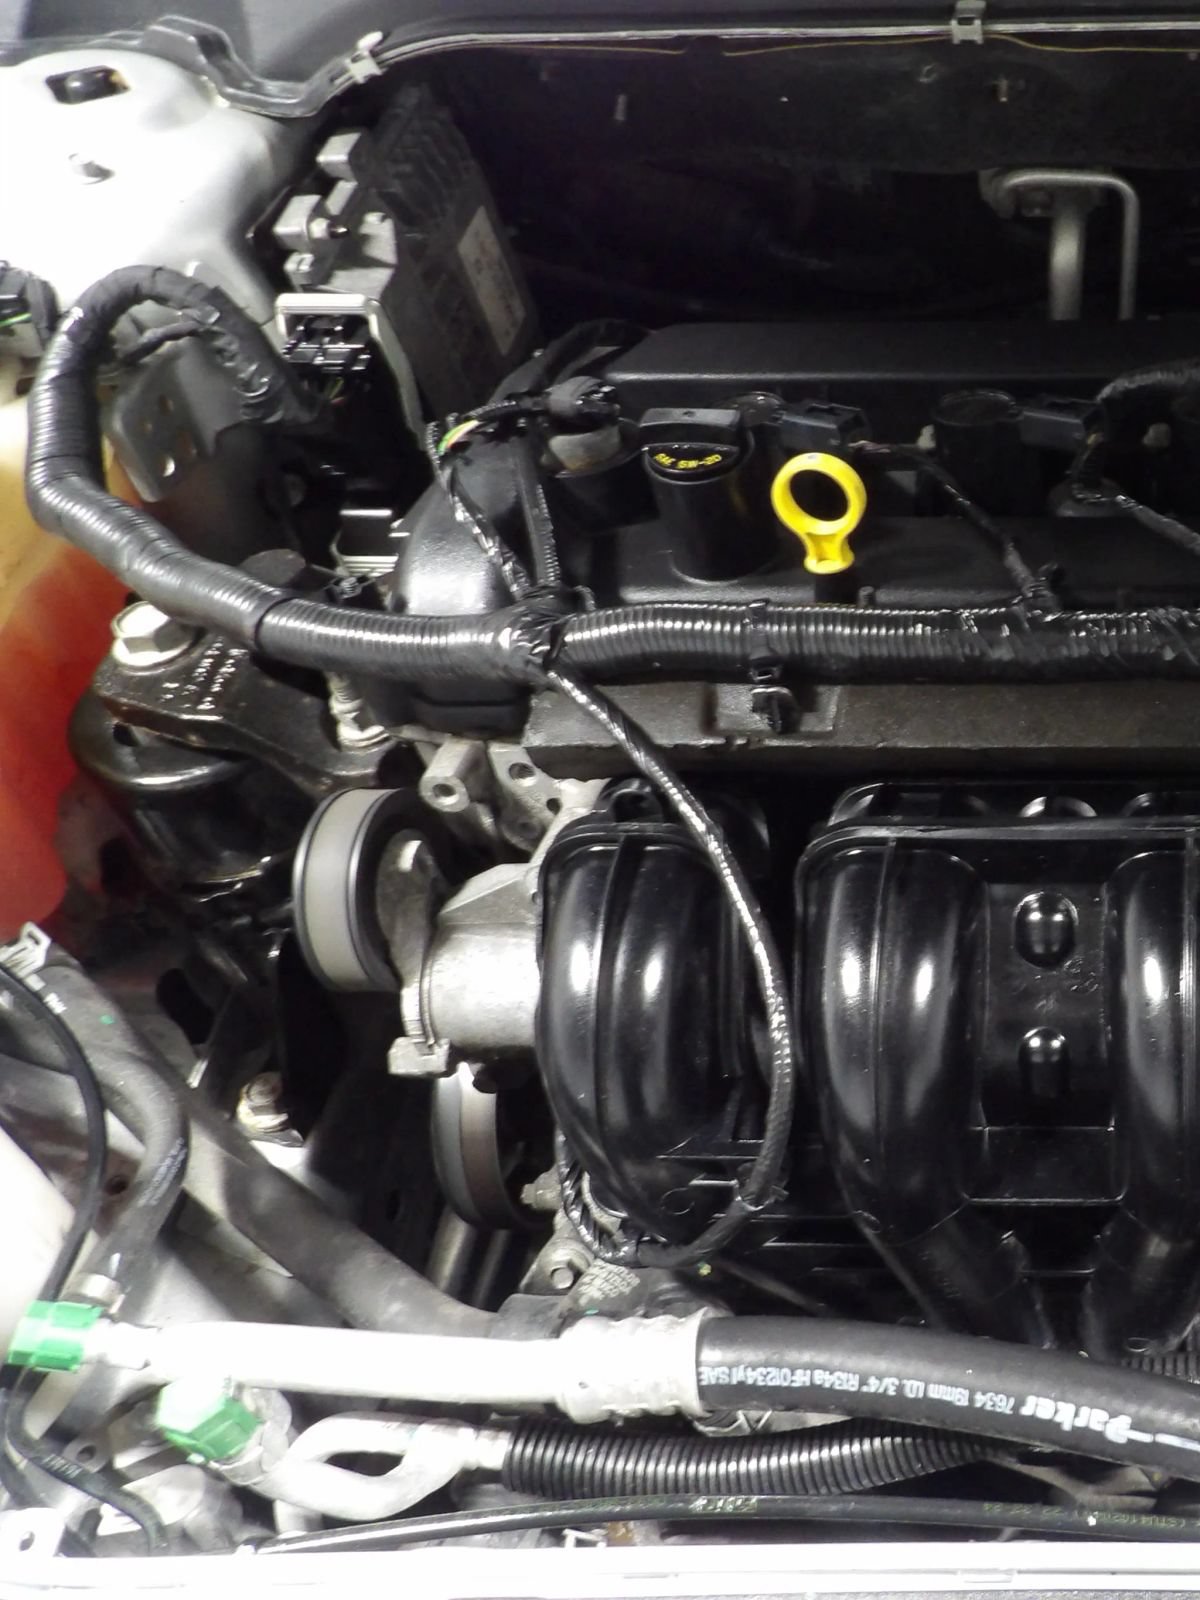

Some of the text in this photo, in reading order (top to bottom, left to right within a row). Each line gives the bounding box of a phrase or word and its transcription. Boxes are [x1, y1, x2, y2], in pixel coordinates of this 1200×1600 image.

[698, 1366, 730, 1386] SAE
[812, 1368, 860, 1392] R134a
[926, 1383, 970, 1406] 19mm
[974, 1391, 1016, 1414] 7634
[1019, 1395, 1133, 1444] Parker
